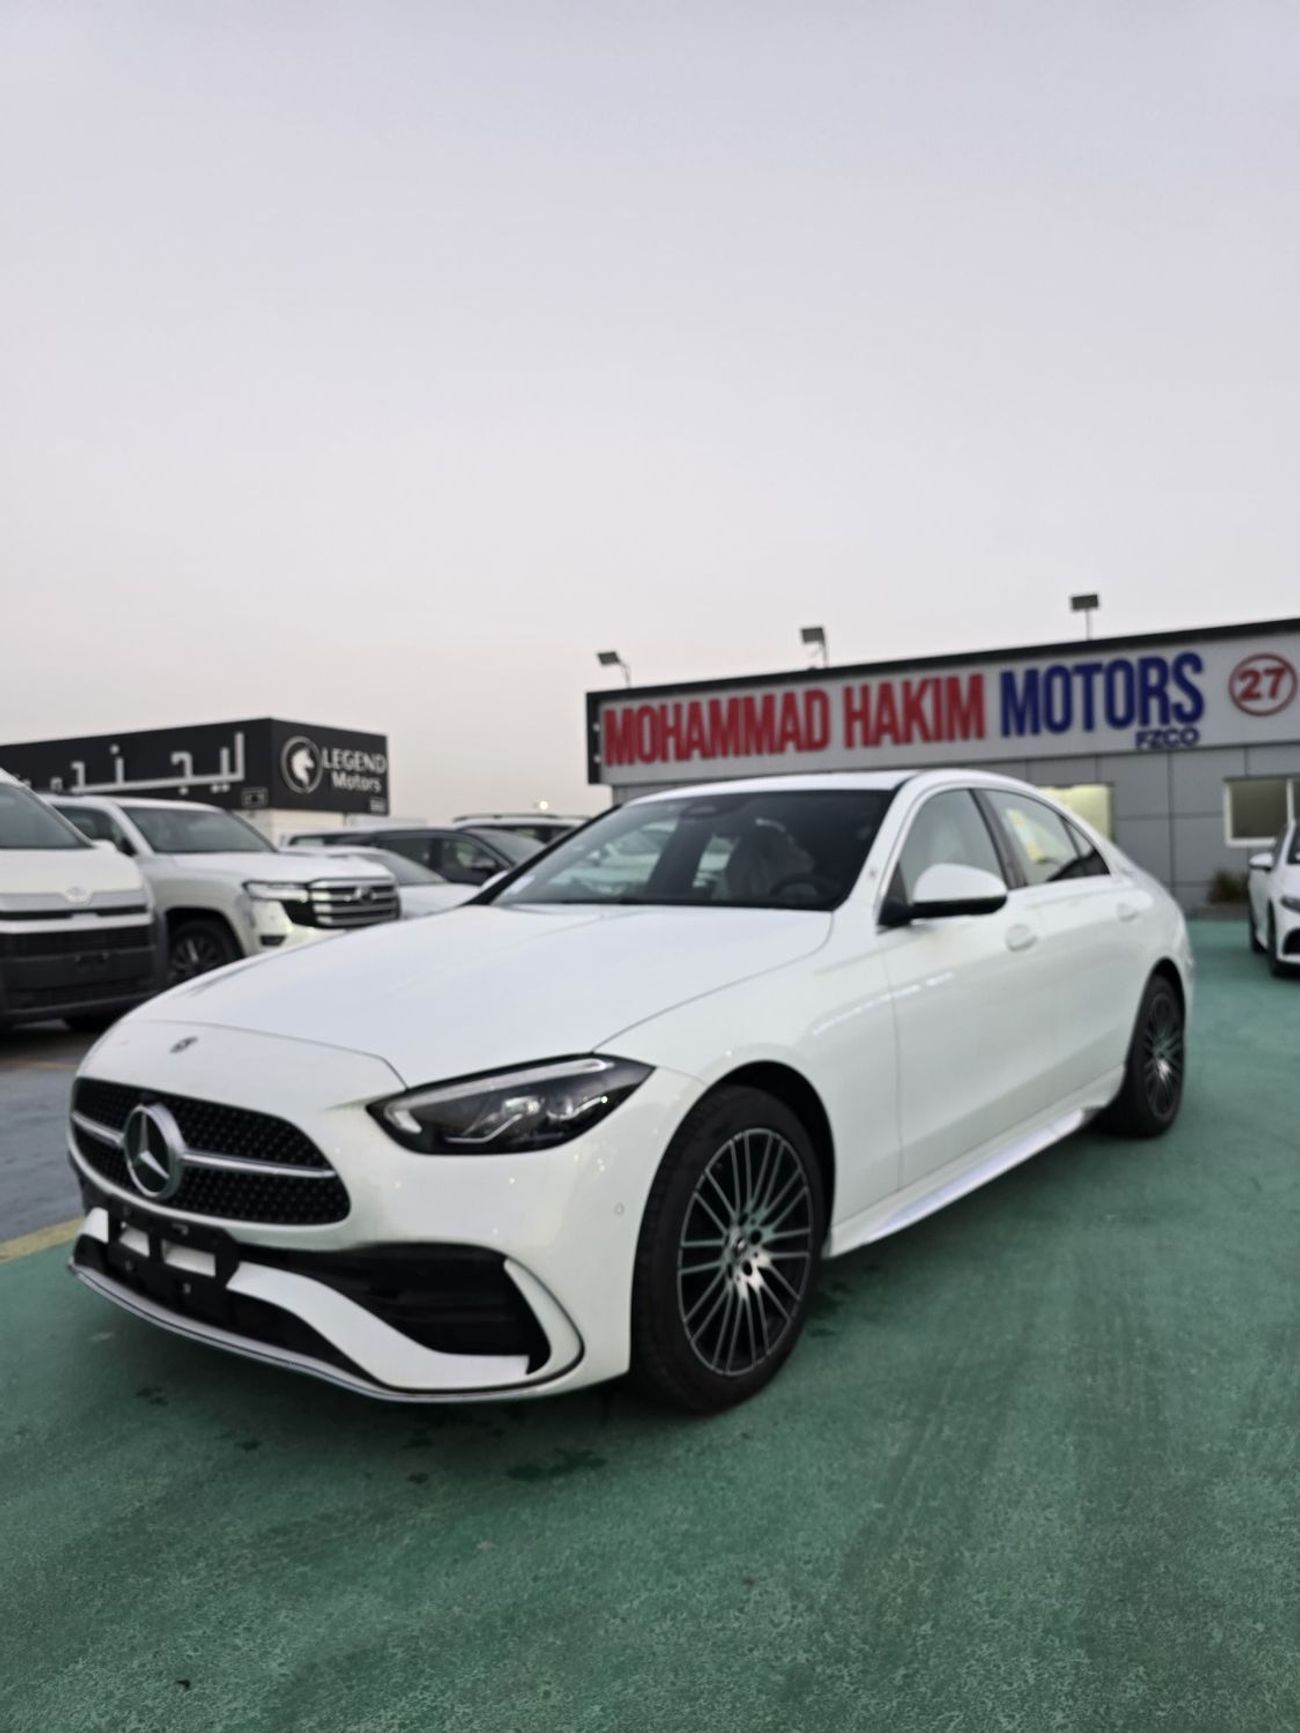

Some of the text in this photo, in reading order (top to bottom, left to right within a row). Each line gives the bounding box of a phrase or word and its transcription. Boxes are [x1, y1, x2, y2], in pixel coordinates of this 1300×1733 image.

[1237, 667, 1286, 701] 27
[604, 653, 1204, 766] MOHAMMAD HAKIM MOTORS
[1136, 728, 1200, 748] FZCO
[322, 748, 387, 774] LEGEND
[331, 772, 381, 793] Motors
